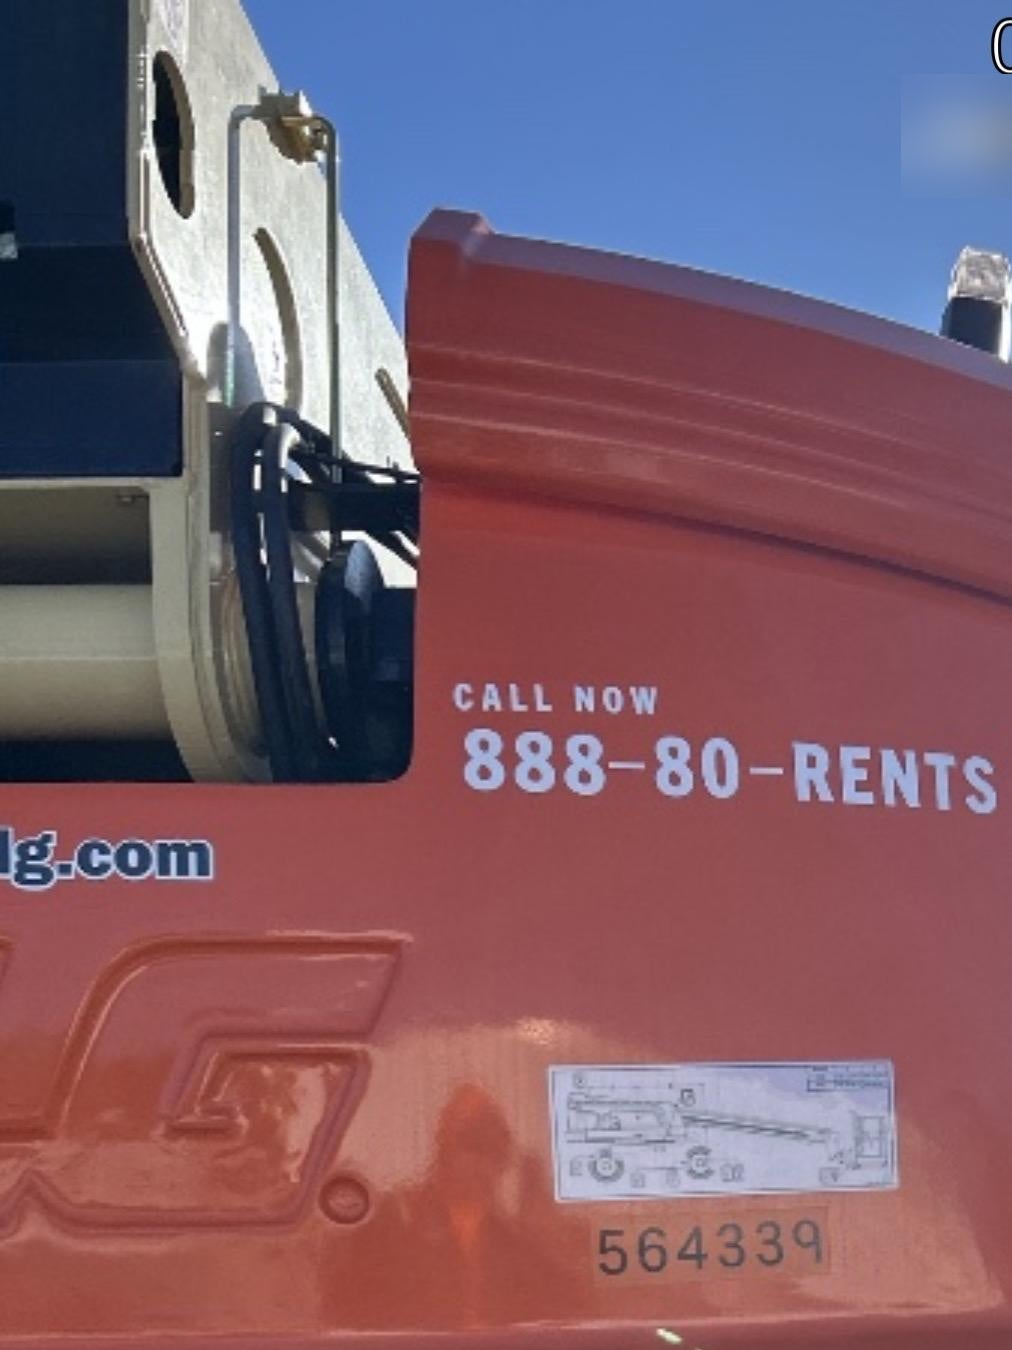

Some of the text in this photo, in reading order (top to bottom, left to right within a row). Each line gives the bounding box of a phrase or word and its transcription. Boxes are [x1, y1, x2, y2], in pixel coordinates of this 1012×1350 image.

[453, 683, 658, 714] CALL NOW
[463, 728, 998, 814] 888-80-RENTS
[597, 1219, 823, 1275] 564339
